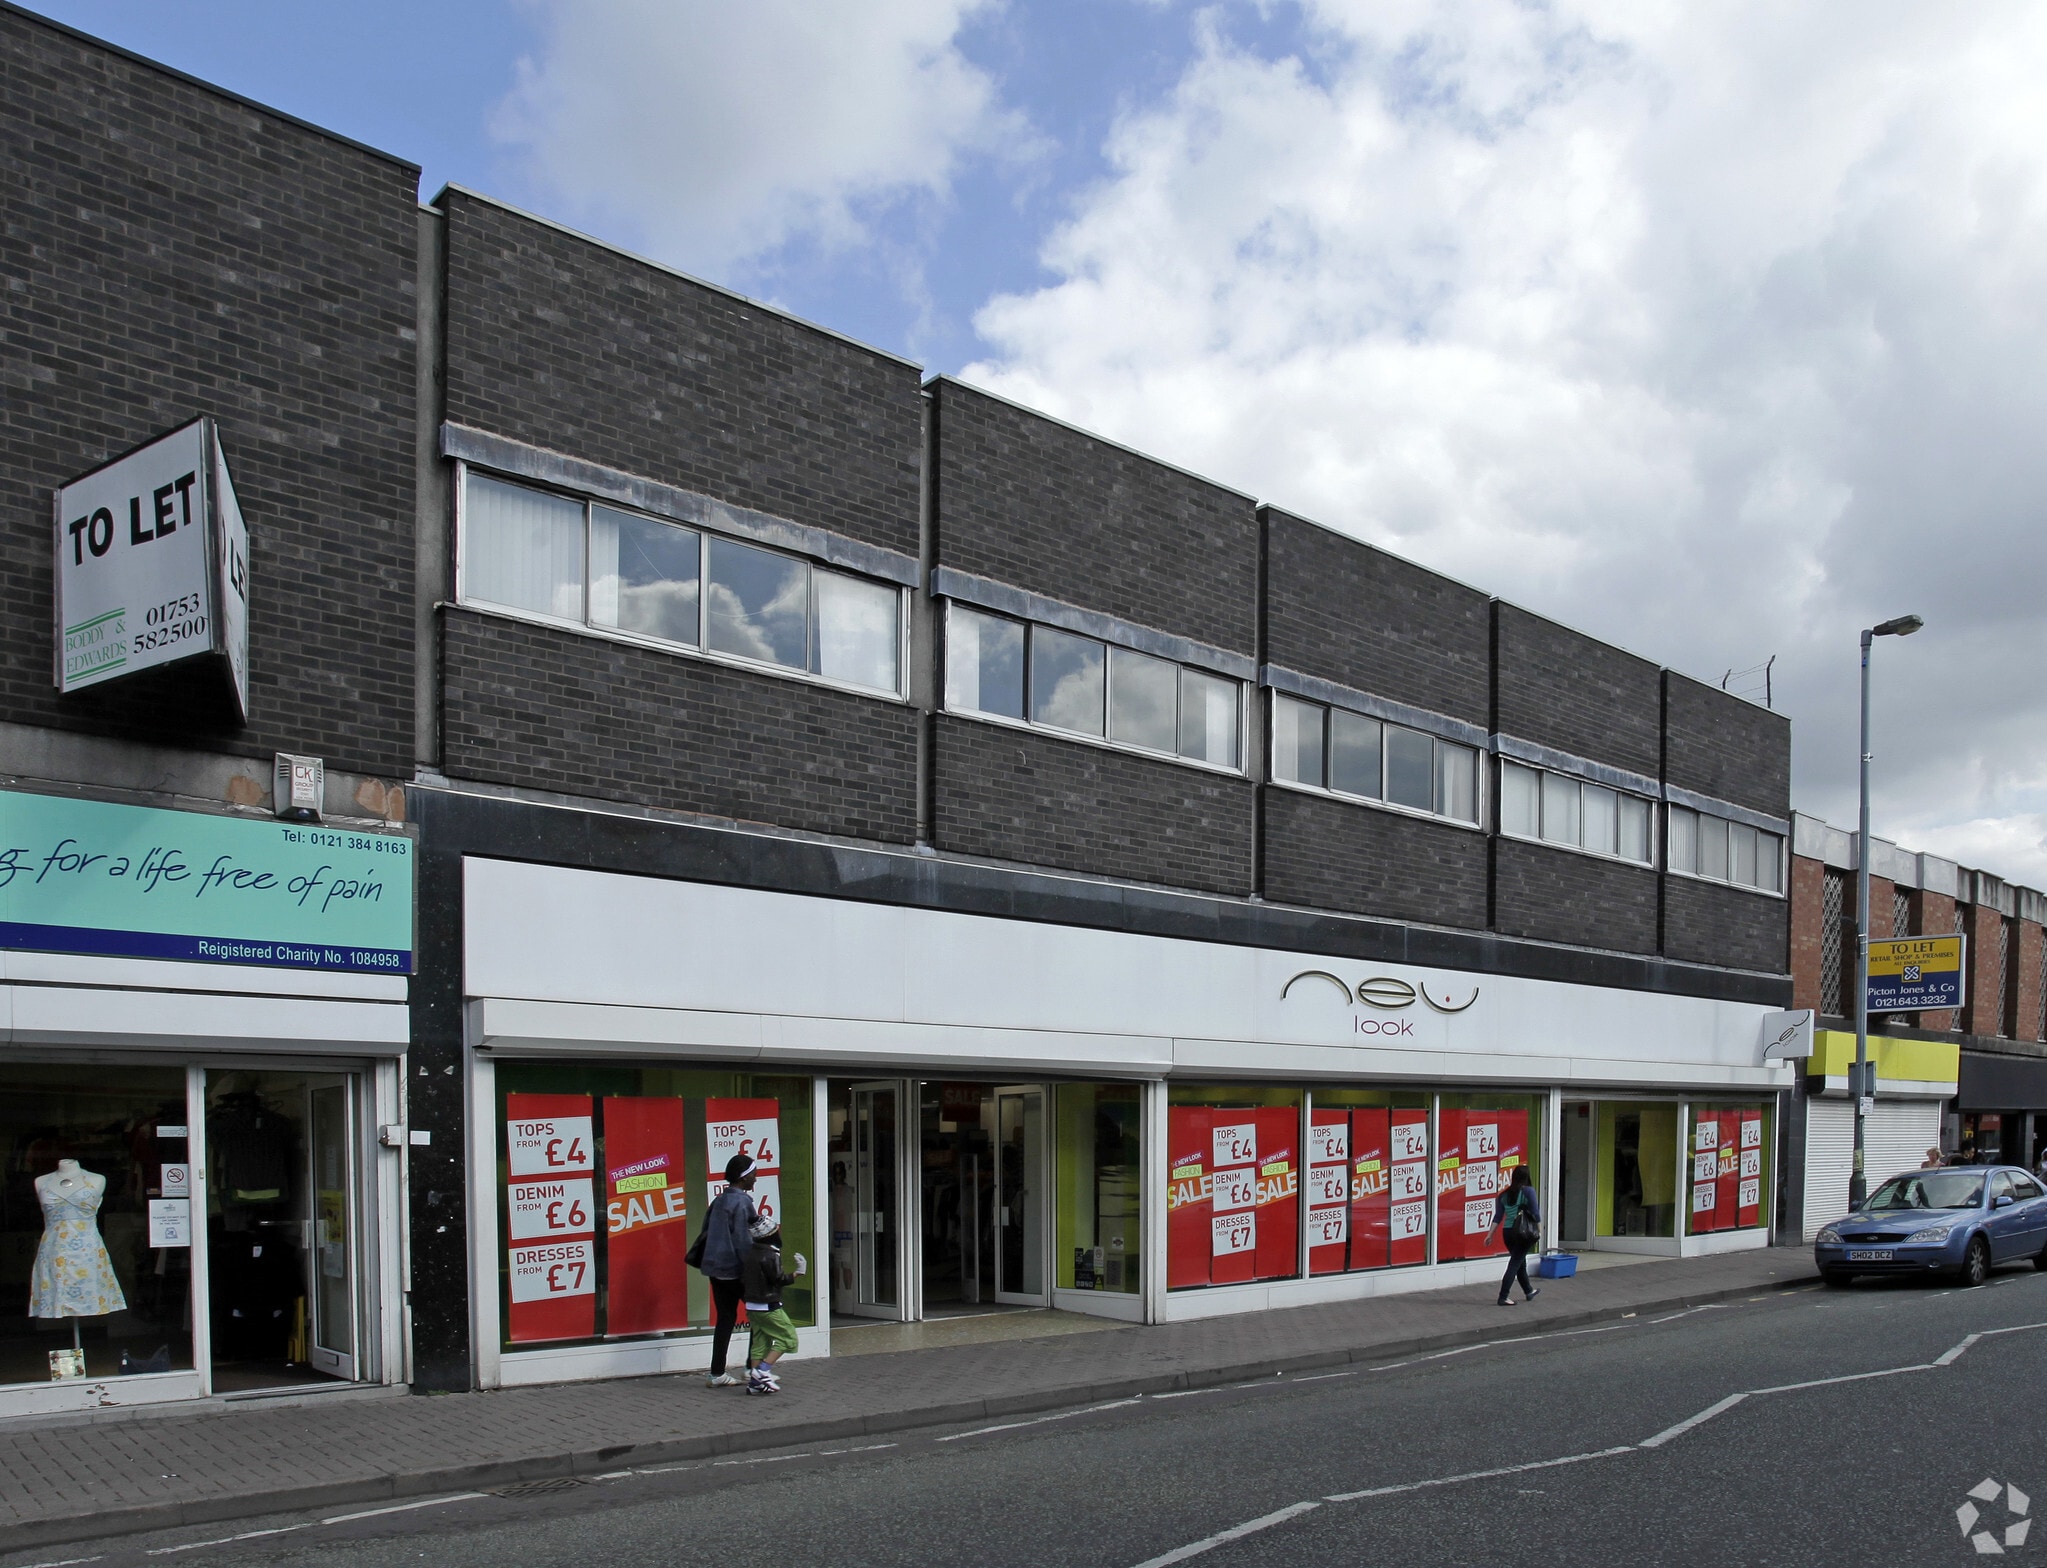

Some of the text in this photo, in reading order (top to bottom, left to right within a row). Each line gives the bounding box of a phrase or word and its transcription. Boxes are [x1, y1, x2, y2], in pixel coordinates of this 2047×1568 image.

[69, 507, 114, 566] TO
[130, 470, 195, 546] LET
[231, 536, 245, 604] LE
[146, 593, 200, 626] 01753
[65, 619, 126, 653] BODDY &
[134, 616, 206, 653] 582500
[66, 640, 127, 673] EDWARDS
[282, 829, 406, 855] Tel: 0121 384 8163
[36, 839, 107, 884] for
[109, 858, 129, 876] a
[136, 847, 191, 893] life
[196, 855, 278, 897] free
[288, 865, 332, 906] of
[322, 868, 383, 913] pain
[198, 941, 399, 967] Reigistered Charity No. 1084958
[1890, 942, 1935, 954] TO LET
[1868, 983, 1955, 996] Picton Jones & Co
[1875, 995, 1947, 1007] 0121.643.3232
[1354, 1015, 1414, 1037] look
[516, 1123, 554, 1137] TOPS
[713, 1125, 746, 1138] TOPS
[1217, 1129, 1236, 1139] TOPS
[1313, 1128, 1331, 1138] TOPS
[1394, 1127, 1411, 1137] TOPS
[1470, 1128, 1484, 1136] TOPS
[516, 1137, 586, 1167] FROM £4
[738, 1138, 773, 1162] £4
[1231, 1139, 1252, 1160] £4
[1325, 1138, 1344, 1157] £4
[1406, 1136, 1423, 1155] £4
[1479, 1137, 1495, 1153] £4
[1276, 1150, 1288, 1161] LOOK
[612, 1157, 665, 1180] THE NEW LOOK
[1174, 1167, 1200, 1177] FASHION
[1263, 1164, 1287, 1174] FASHION
[1311, 1169, 1333, 1180] DENIM
[1393, 1166, 1414, 1176] DENIM
[1468, 1165, 1486, 1174] DENIM
[1718, 1155, 1738, 1177] SALE
[620, 1176, 663, 1191] FASHION
[1216, 1173, 1241, 1184] DENIM
[1256, 1171, 1297, 1204] SALE
[1352, 1169, 1388, 1200] SALE
[1405, 1175, 1423, 1194] £6
[1478, 1173, 1493, 1191] £6
[1498, 1168, 1513, 1191] SAL
[516, 1185, 564, 1200] DENIM
[1168, 1174, 1213, 1209] SALE
[1231, 1183, 1252, 1204] £6
[1324, 1179, 1343, 1199] £6
[517, 1200, 586, 1229] FROM £6
[607, 1187, 686, 1232] SALE
[1309, 1210, 1342, 1222] DRESSES
[1393, 1204, 1422, 1216] DRESSES
[1466, 1201, 1492, 1212] DRESSES
[1215, 1215, 1250, 1229] DRESSES
[1405, 1214, 1422, 1234] £7
[1478, 1211, 1492, 1228] £7
[1230, 1227, 1251, 1248] £7
[1323, 1221, 1342, 1241] £7
[516, 1246, 585, 1265] DRESSES
[1851, 1251, 1891, 1259] SH02 DCZ
[517, 1261, 586, 1292] FROM £7
